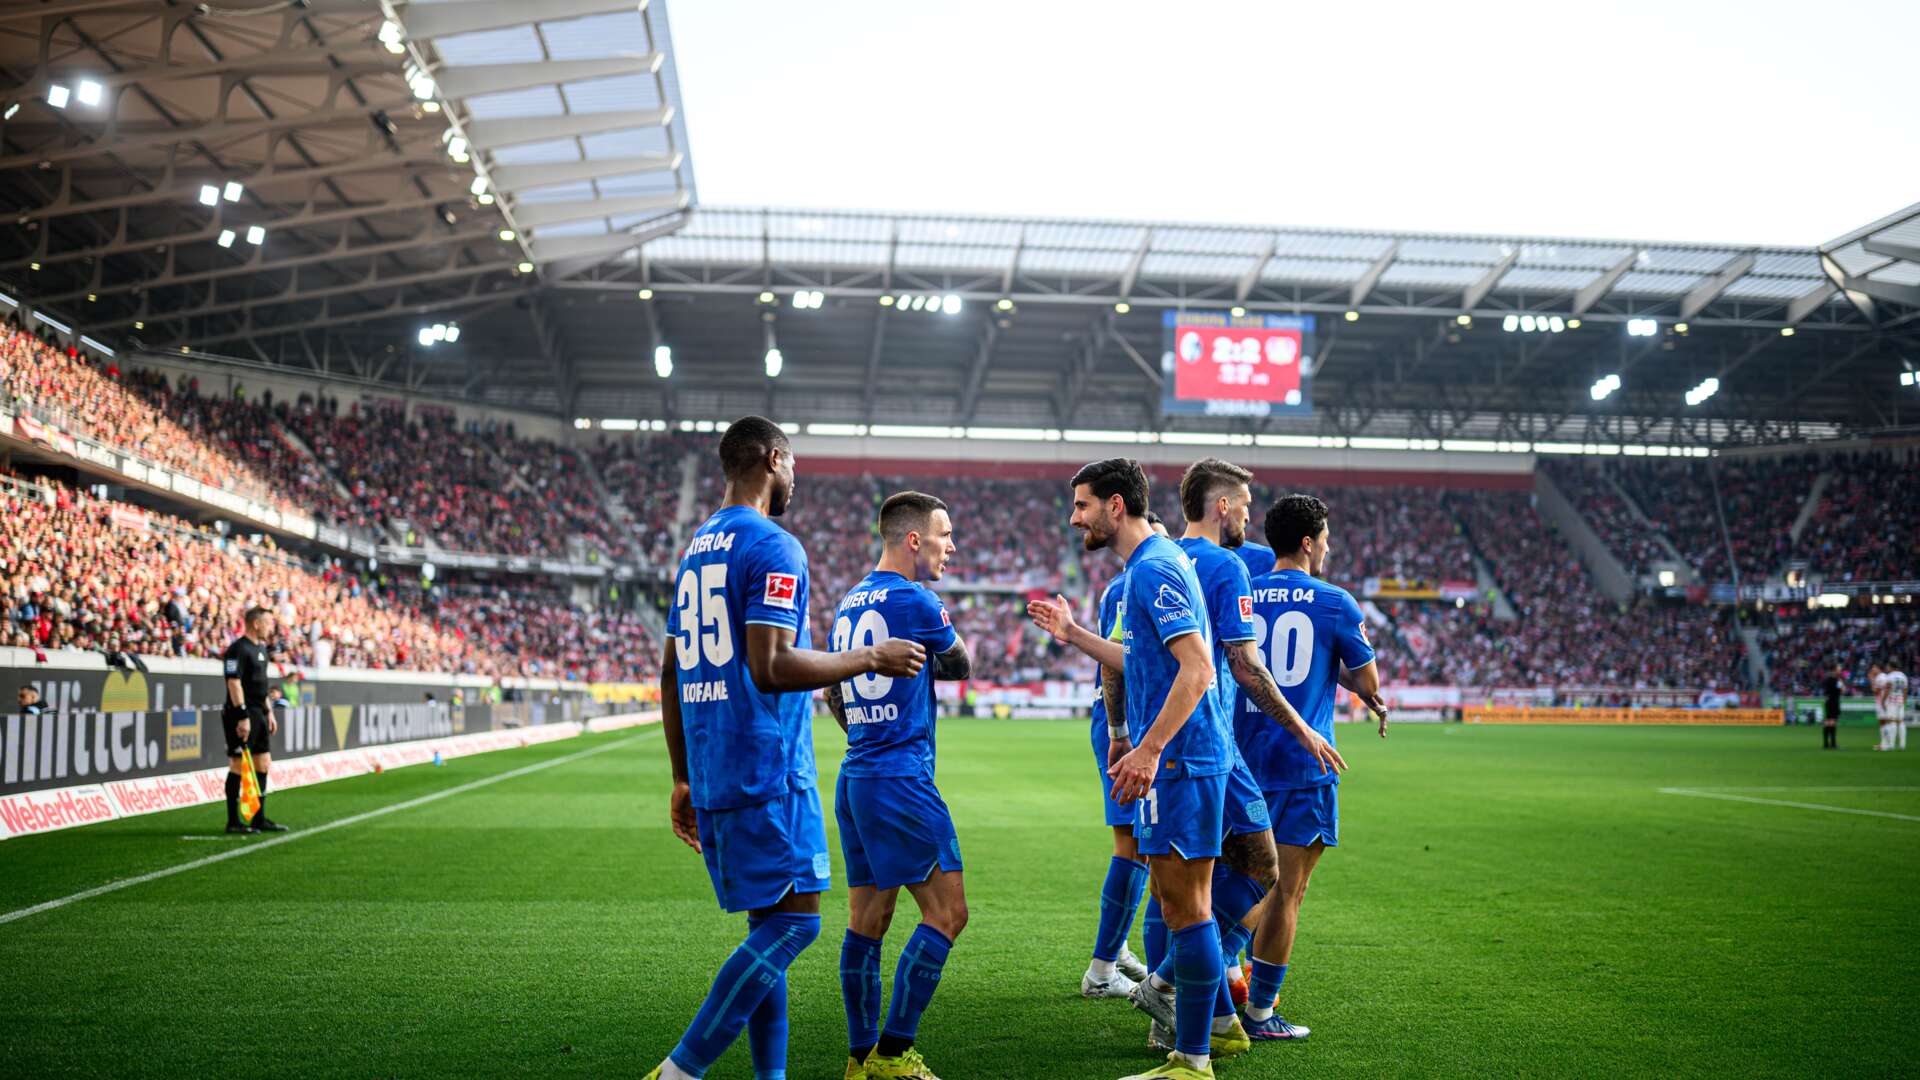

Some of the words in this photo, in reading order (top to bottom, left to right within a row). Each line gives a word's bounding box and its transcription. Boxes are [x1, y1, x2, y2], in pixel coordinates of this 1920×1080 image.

[713, 531, 736, 551] 04
[868, 588, 889, 604] 04
[1253, 588, 1289, 603] YER
[1292, 588, 1315, 604] 04
[676, 563, 735, 671] 35
[683, 679, 729, 704] KOFANE
[0, 791, 112, 833] WeberHaus
[111, 776, 199, 814] WeberHaus
